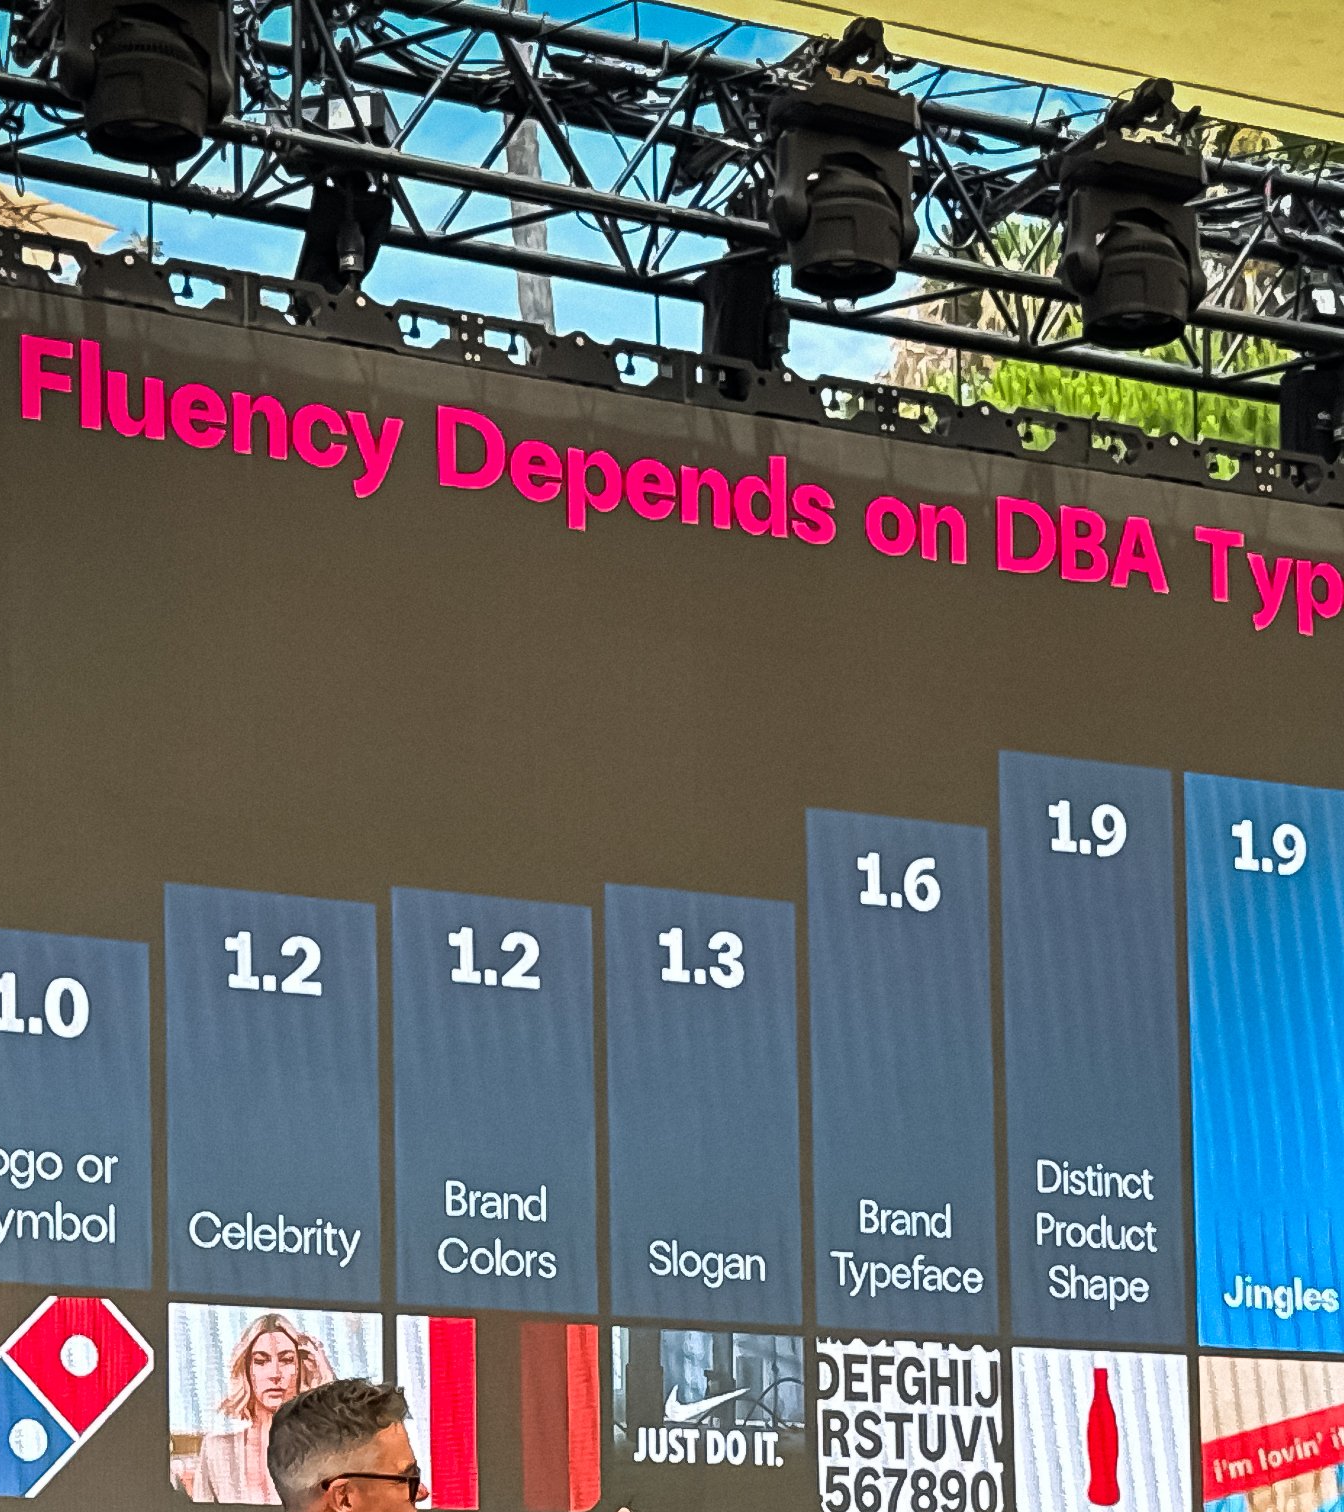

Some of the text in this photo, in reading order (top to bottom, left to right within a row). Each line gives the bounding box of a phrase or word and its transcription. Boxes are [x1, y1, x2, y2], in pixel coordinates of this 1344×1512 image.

[21, 334, 404, 498] Fluency
[437, 404, 837, 546] Depends
[865, 496, 967, 564] on
[996, 495, 1169, 594] DBA
[1048, 799, 1127, 857] 1.9
[1231, 819, 1307, 876] 1.9
[857, 852, 941, 912] 1.6
[224, 931, 322, 996] 1.2
[448, 926, 541, 990] 1.2
[658, 927, 745, 989] 1.3
[76, 1154, 119, 1184] or
[1036, 1159, 1155, 1201] Distinct
[445, 1180, 547, 1223] Brand
[859, 1199, 952, 1239] Brand
[189, 1211, 361, 1268] Celebrity
[1036, 1212, 1158, 1253] Product
[437, 1237, 557, 1280] Colors
[649, 1239, 766, 1289] Slogan
[829, 1250, 984, 1298] Typeface
[1048, 1264, 1150, 1311] Shape
[1224, 1275, 1339, 1319] Jingles
[817, 1352, 998, 1408] DEFGHIJ
[633, 1426, 784, 1467] JUST DO IT.
[1258, 1432, 1323, 1470] lovin'
